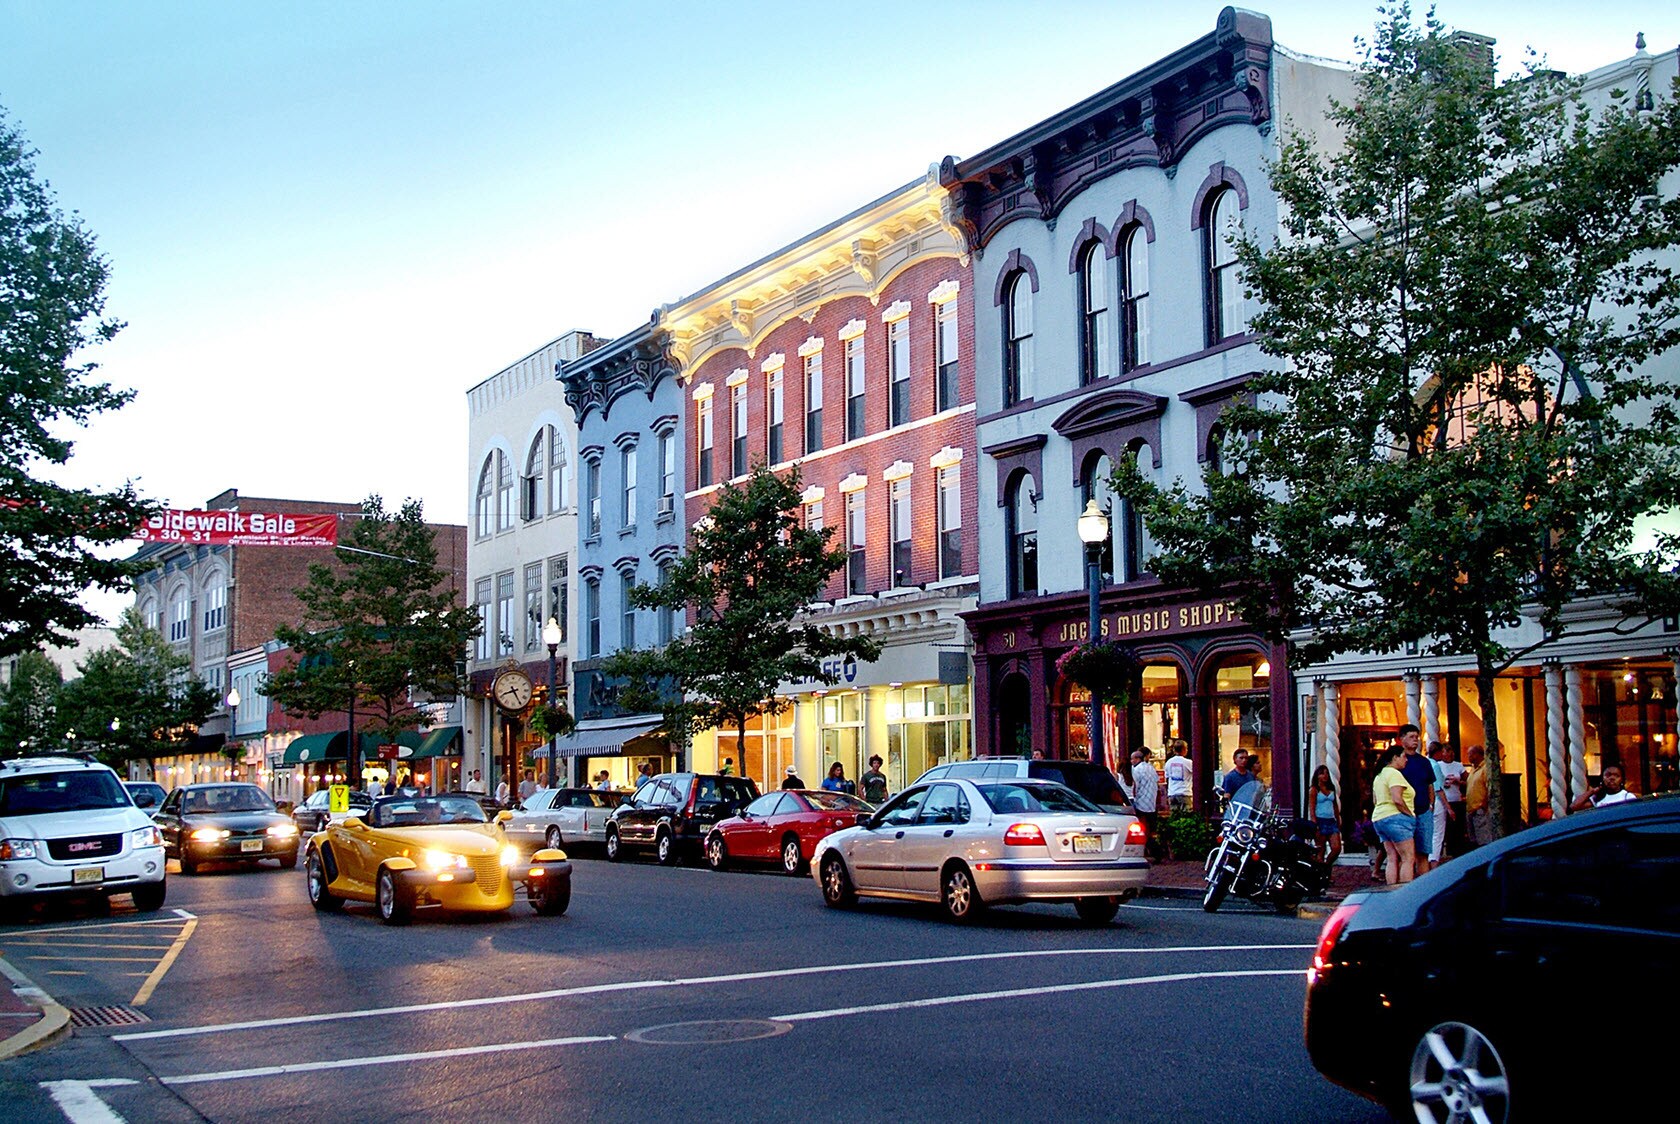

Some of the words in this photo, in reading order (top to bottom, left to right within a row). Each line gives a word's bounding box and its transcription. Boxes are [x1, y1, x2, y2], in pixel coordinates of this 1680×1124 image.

[148, 511, 245, 532] Sidewalk
[250, 514, 296, 533] Sale
[161, 529, 186, 541] 30,
[192, 531, 211, 541] 31
[1060, 618, 1109, 642] JACS
[1117, 610, 1170, 635] MUSIC
[1180, 602, 1243, 627] SHOPP
[68, 841, 102, 852] GMC
